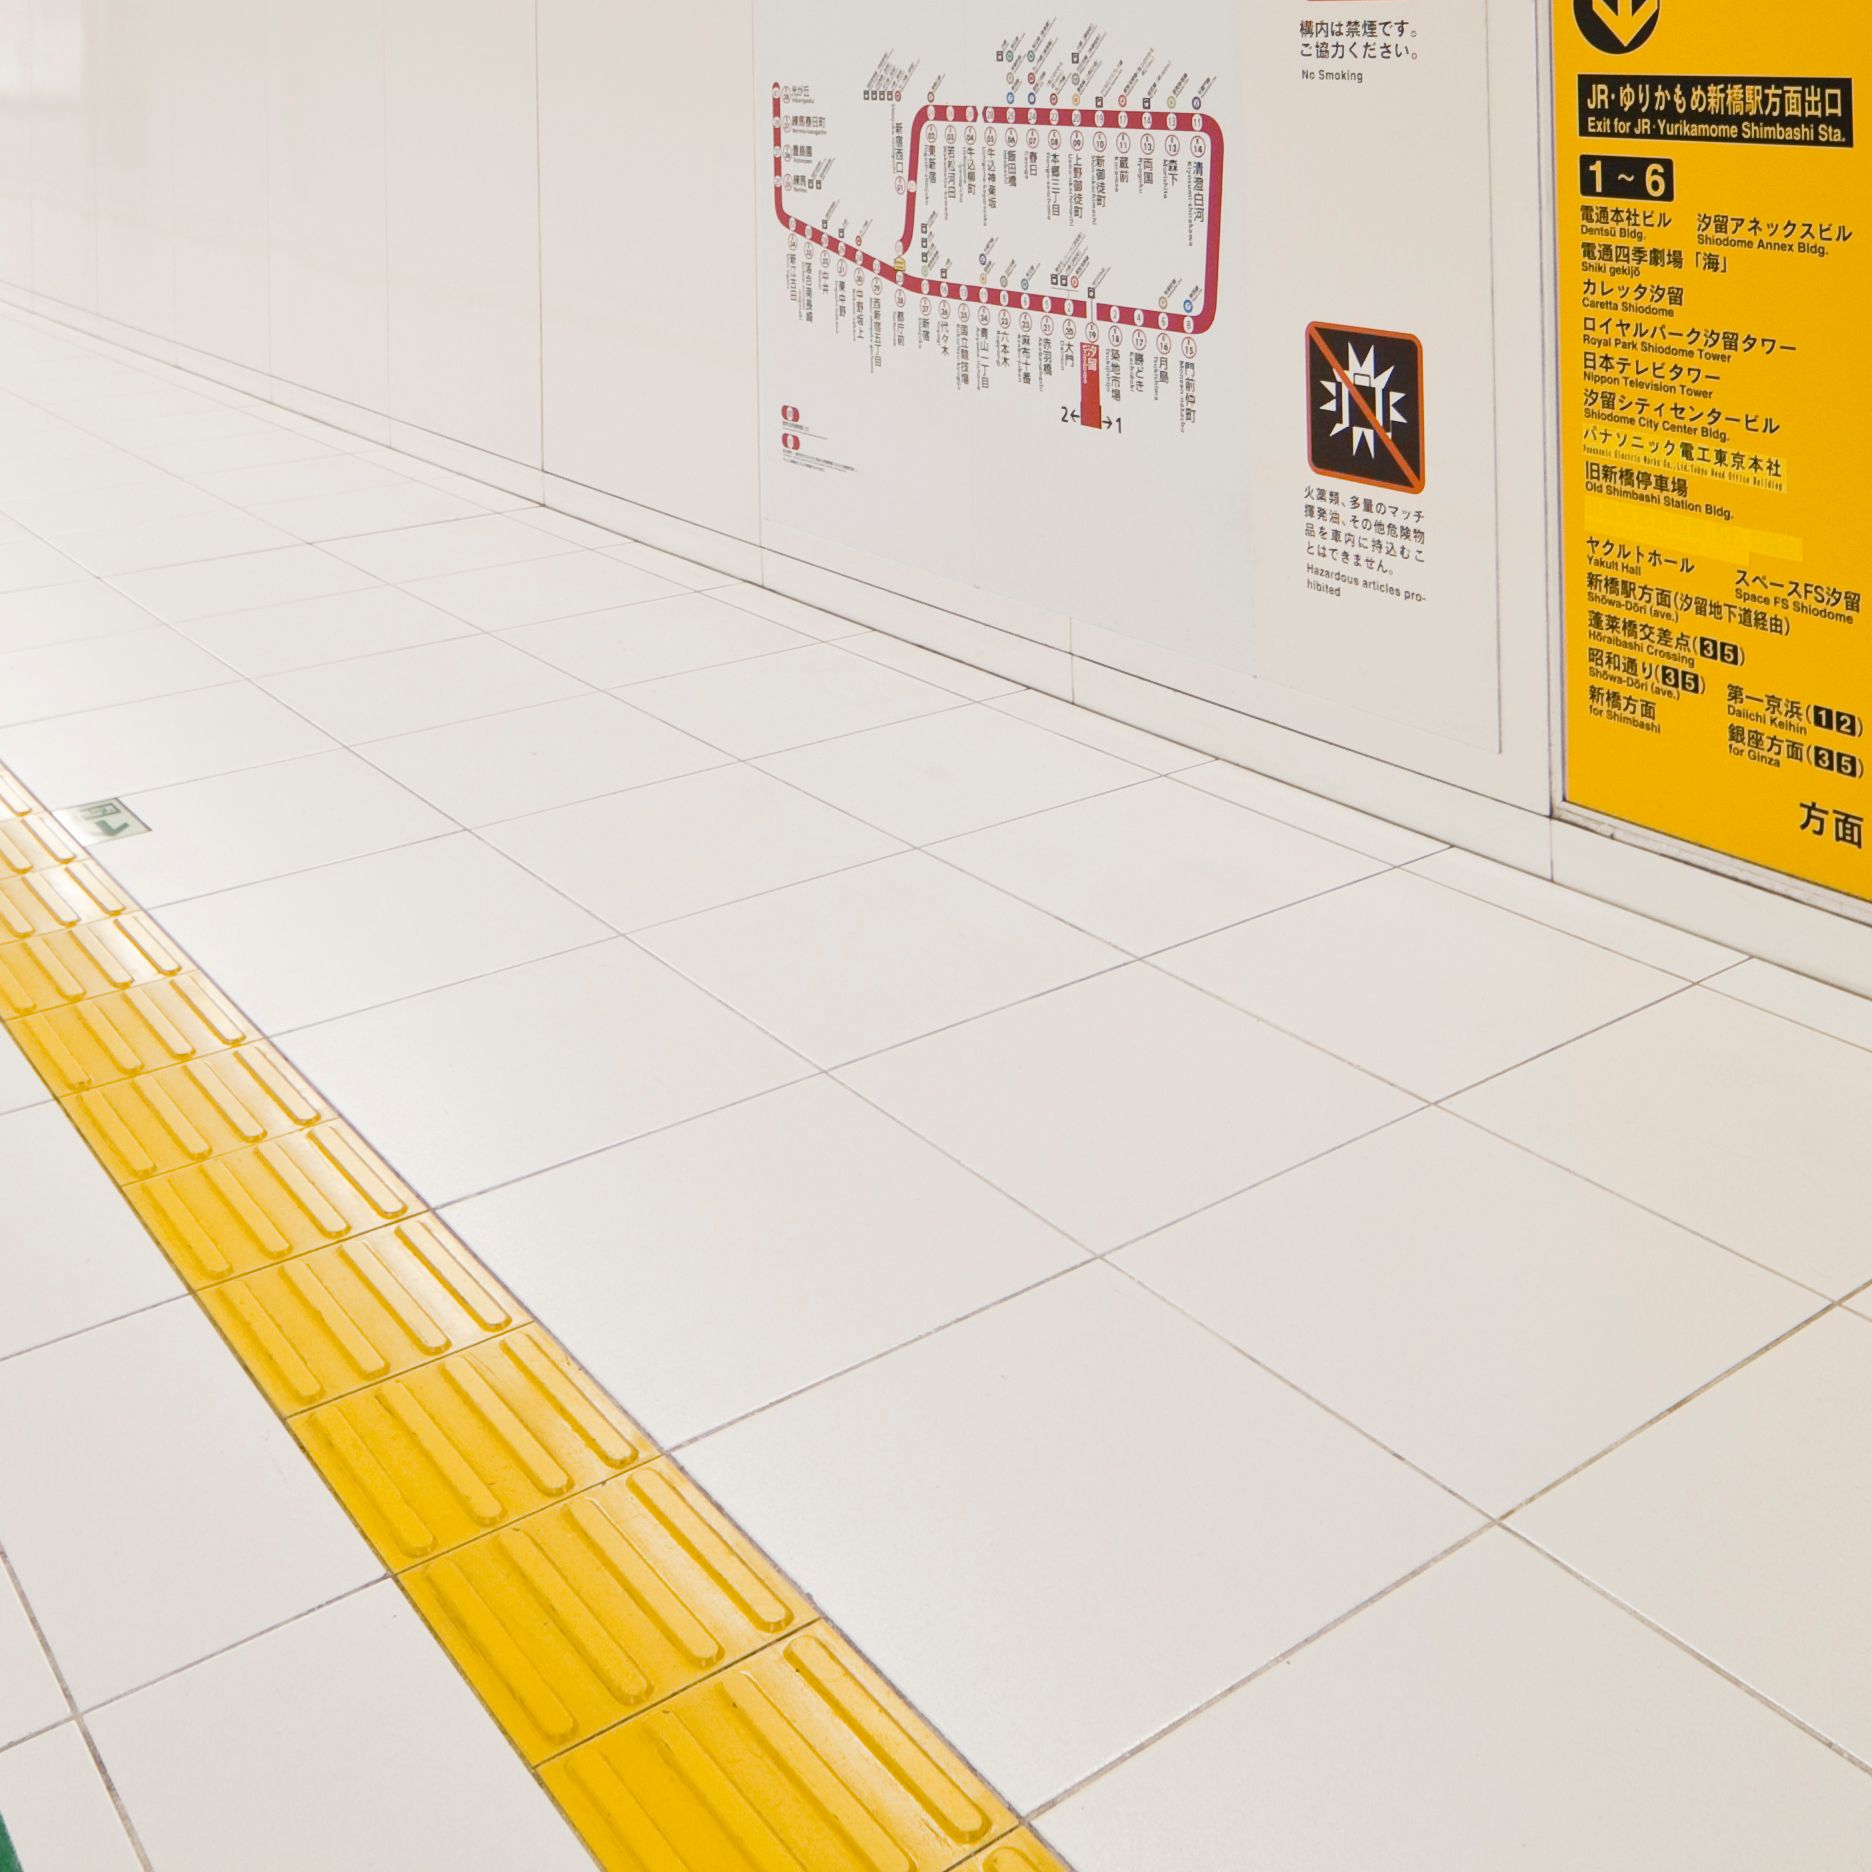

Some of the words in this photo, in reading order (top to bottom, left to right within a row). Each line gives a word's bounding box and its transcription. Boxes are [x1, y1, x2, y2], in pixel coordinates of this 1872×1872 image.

[1300, 20, 1417, 38] 構内は禁煙です。
[1301, 41, 1417, 60] ご協力ください。
[1302, 69, 1315, 80] No
[1318, 70, 1363, 83] Smoking
[1588, 117, 1610, 132] Exit
[1614, 117, 1630, 133] for
[1742, 123, 1814, 141] Shimbashi
[1819, 126, 1846, 142] Sta.
[1580, 205, 1671, 228] 電通本社ビル
[1697, 212, 1852, 243] 汐留アネックスビル
[1697, 234, 1754, 249] Shiodome
[1757, 238, 1793, 253] Annex
[1798, 242, 1828, 256] Bldg.
[1581, 262, 1606, 274] Shiki
[1582, 297, 1618, 311] Caretta
[1622, 301, 1674, 317] Shiodome
[1583, 278, 1683, 307] カレッタ汐留
[1583, 334, 1612, 348] Royal
[1614, 338, 1638, 351] Park
[1641, 342, 1694, 358] Shiodome
[1698, 349, 1731, 363] Tower
[1584, 317, 1796, 352] ロイヤルパーク汐留タワー
[1583, 351, 1720, 383] 日本テレビタワー
[1061, 407, 1068, 422] 2
[1116, 418, 1121, 433] 1
[1583, 388, 1780, 435] 汐留シティセンタービル
[1583, 426, 1781, 479] パナソニック電工東京本社
[1585, 460, 1687, 498] 旧新橋停車場
[1307, 542, 1393, 576] とはできません。
[1587, 536, 1695, 574] ヤクルトホール
[1587, 556, 1619, 573] Yakult
[1622, 564, 1641, 576] Hall
[1307, 563, 1359, 586] Hazardous
[1362, 577, 1400, 597] articles
[1404, 589, 1426, 602] pro-
[1307, 579, 1340, 597] hibited
[1736, 569, 1860, 613] スペースFS汐留
[1589, 684, 1656, 720] 新橋方面
[1589, 704, 1603, 716] for
[1606, 709, 1660, 734] Shimbashi
[1728, 705, 1766, 724] Daiichi
[1770, 717, 1807, 736] Keihin
[1728, 743, 1744, 757] for
[1748, 748, 1780, 768] Ginza
[1800, 800, 1863, 848] 方面
